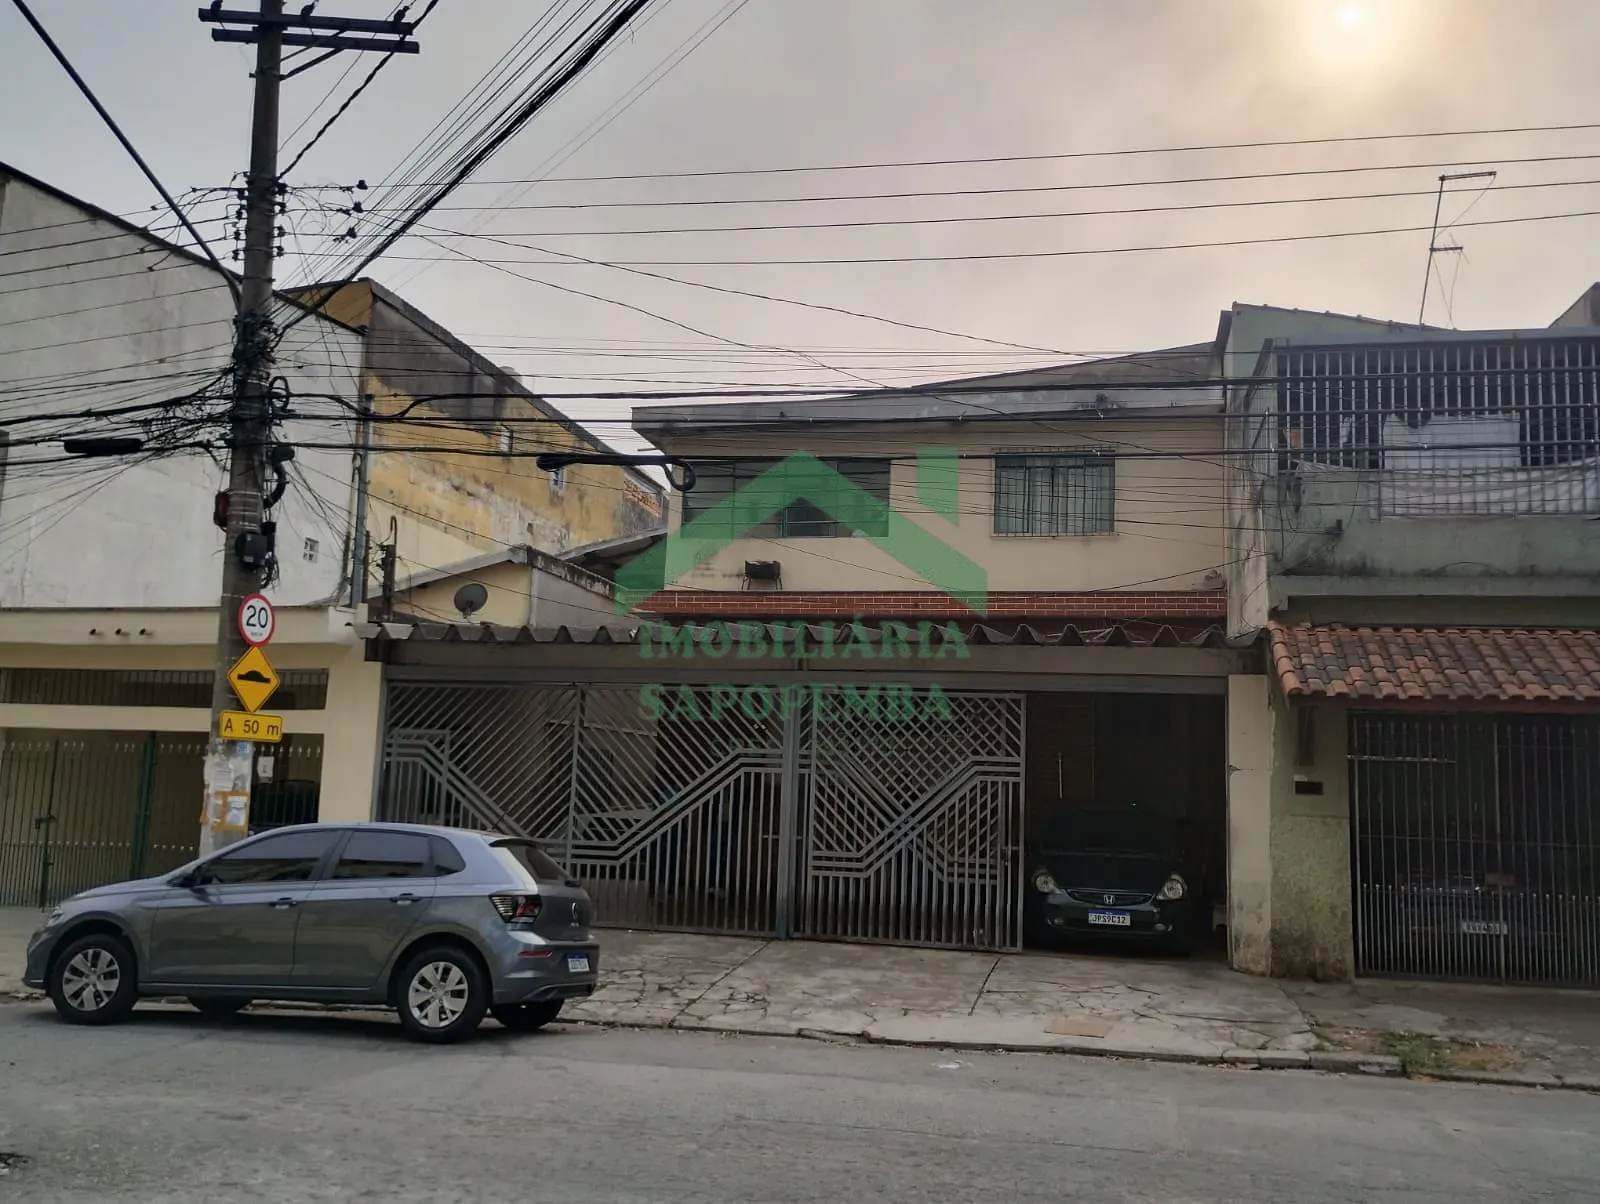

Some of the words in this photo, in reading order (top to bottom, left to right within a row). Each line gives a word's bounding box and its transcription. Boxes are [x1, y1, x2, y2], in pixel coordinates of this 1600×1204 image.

[246, 605, 269, 628] 20
[223, 718, 233, 733] A
[243, 719, 260, 734] 50
[266, 724, 279, 736] m
